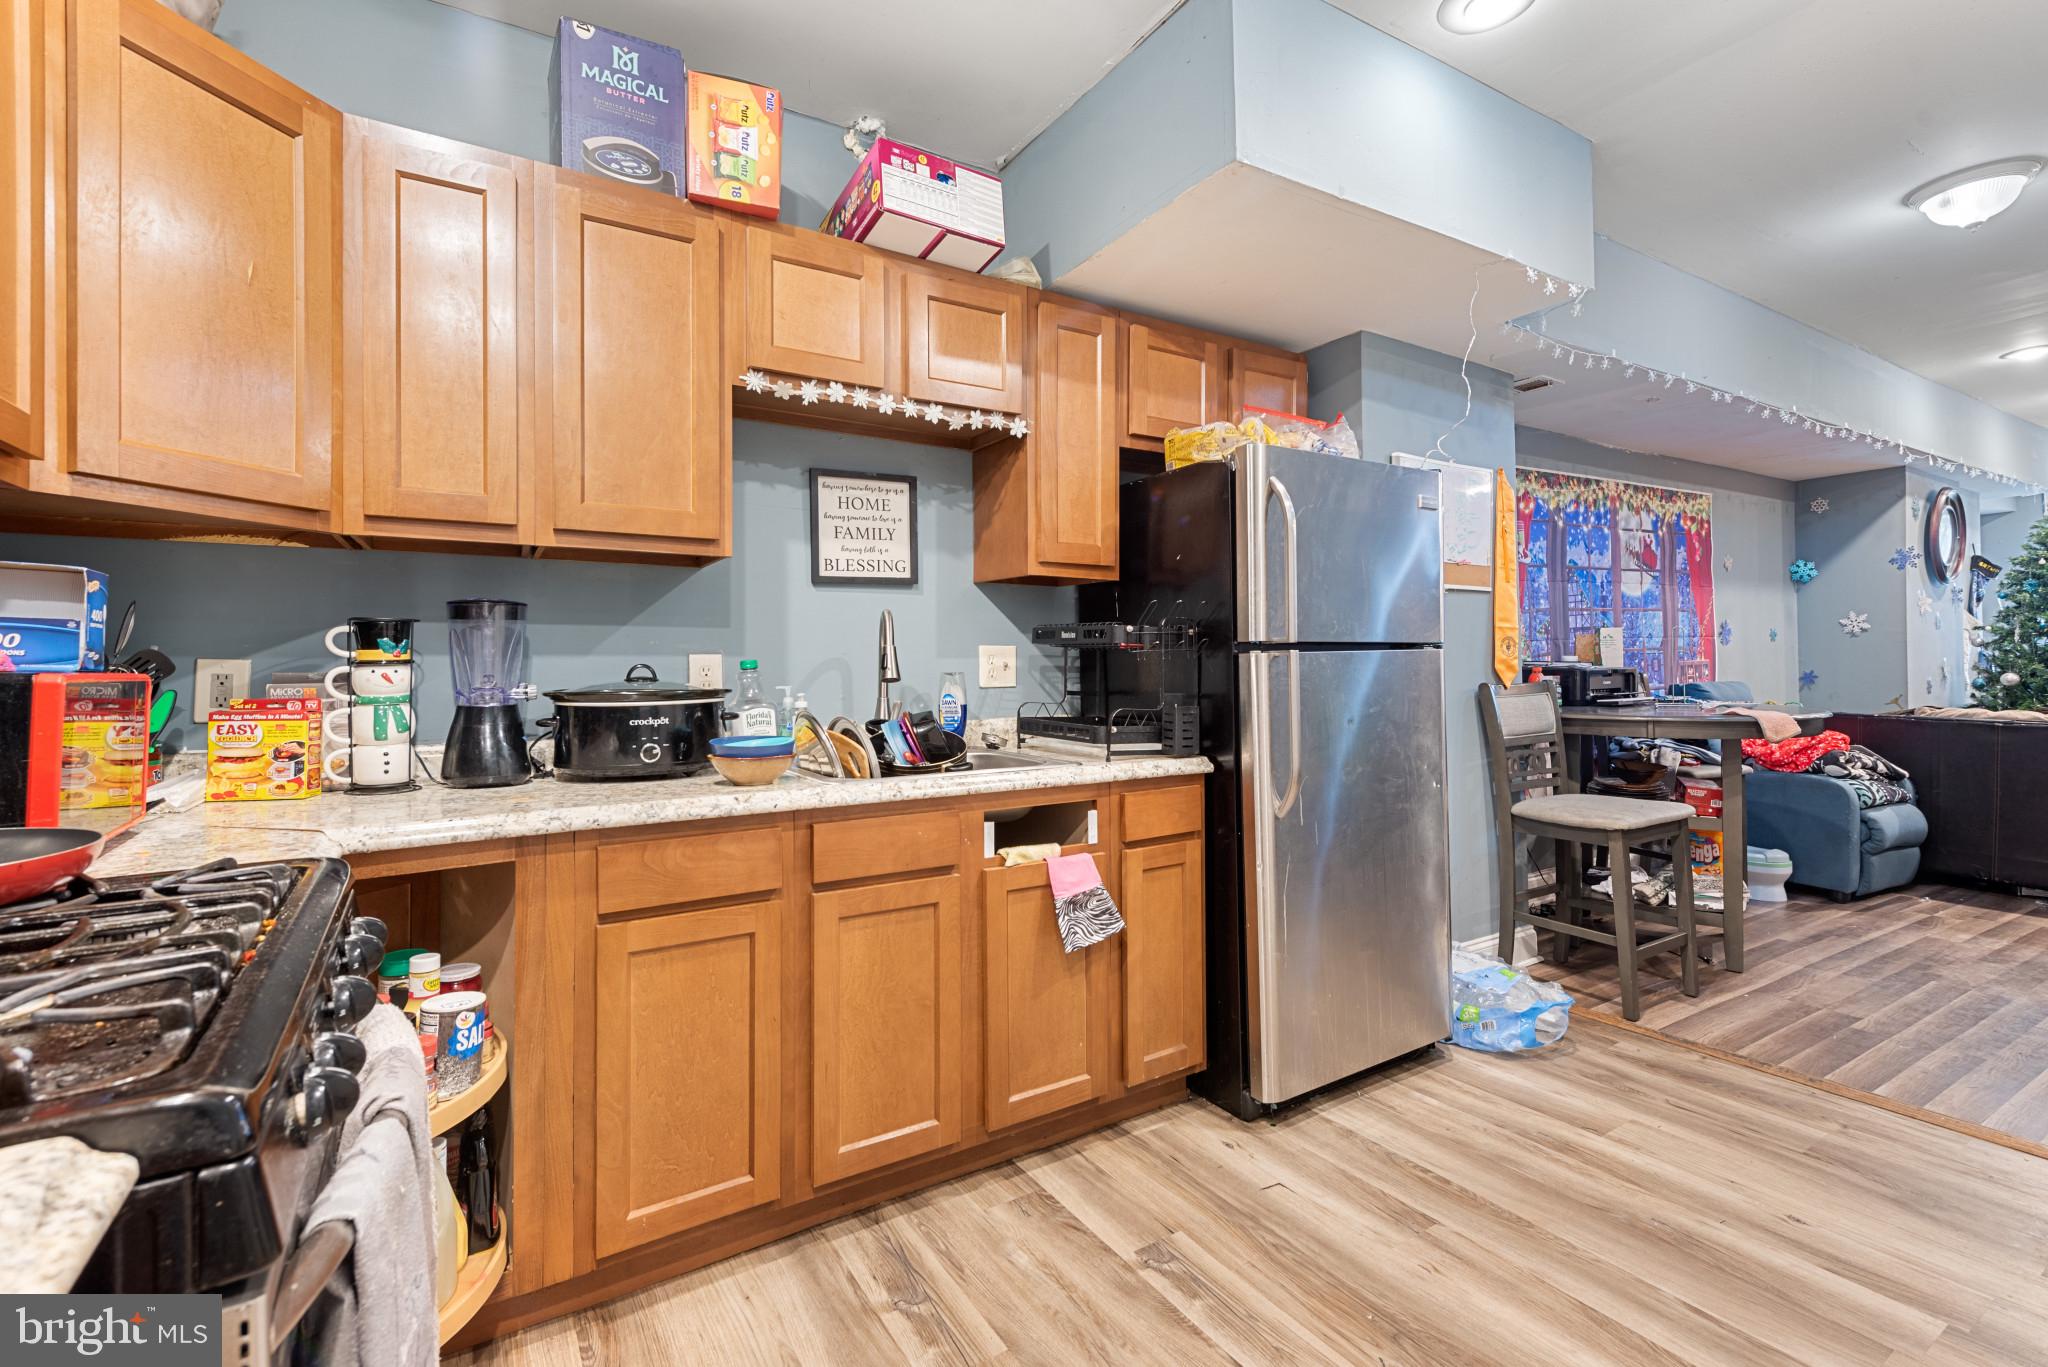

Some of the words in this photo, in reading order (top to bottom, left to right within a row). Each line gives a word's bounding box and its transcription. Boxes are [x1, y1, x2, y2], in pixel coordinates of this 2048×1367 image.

[581, 62, 669, 104] MAGICAL
[606, 87, 646, 104] BUTTER
[731, 185, 742, 198] 18
[837, 496, 891, 512] HOME
[834, 525, 896, 541] FAMILY
[823, 558, 907, 573] BLESSING
[629, 716, 669, 727] crockpot
[216, 724, 258, 736] EASY
[1690, 843, 1720, 862] enga
